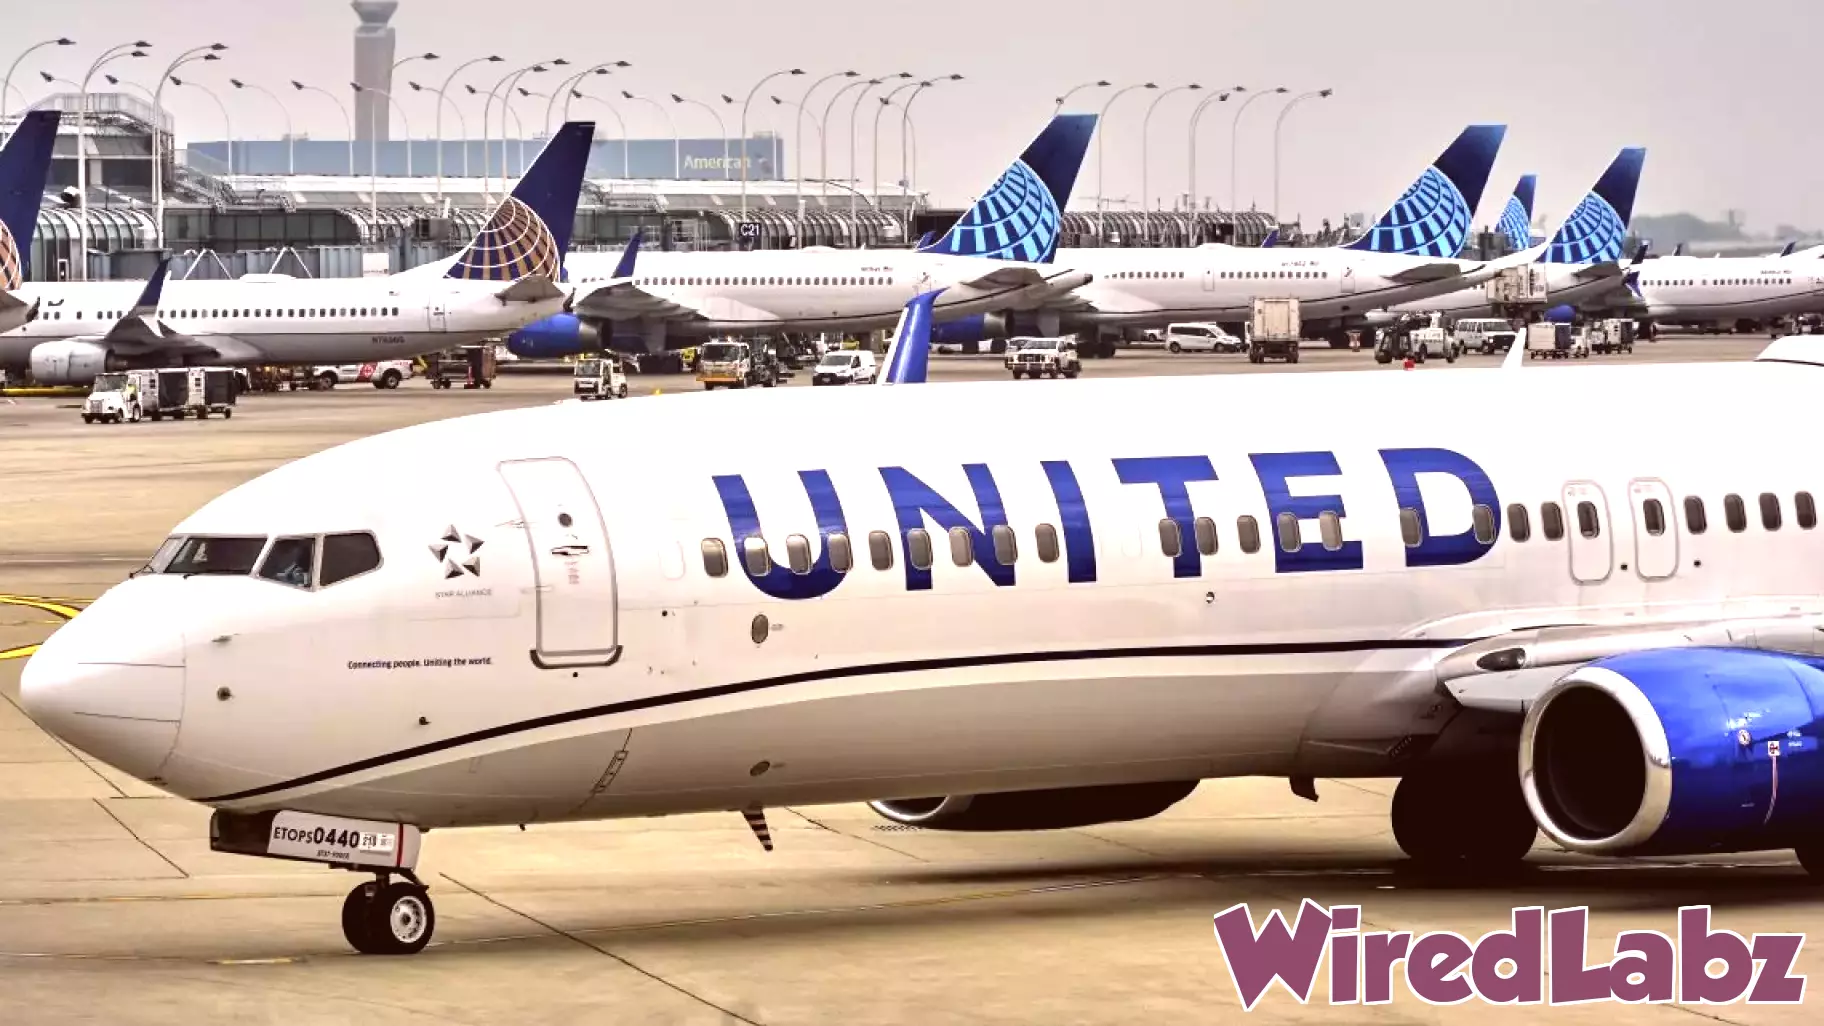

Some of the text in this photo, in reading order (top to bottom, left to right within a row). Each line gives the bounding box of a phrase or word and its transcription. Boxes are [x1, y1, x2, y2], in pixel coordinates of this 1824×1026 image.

[683, 154, 752, 170] American
[740, 223, 761, 237] C21
[711, 447, 1502, 600] UNITED
[435, 587, 492, 599] STAR ALLIANCE
[347, 660, 392, 670] Connecting
[423, 658, 452, 667] Uniting
[454, 657, 466, 665] the
